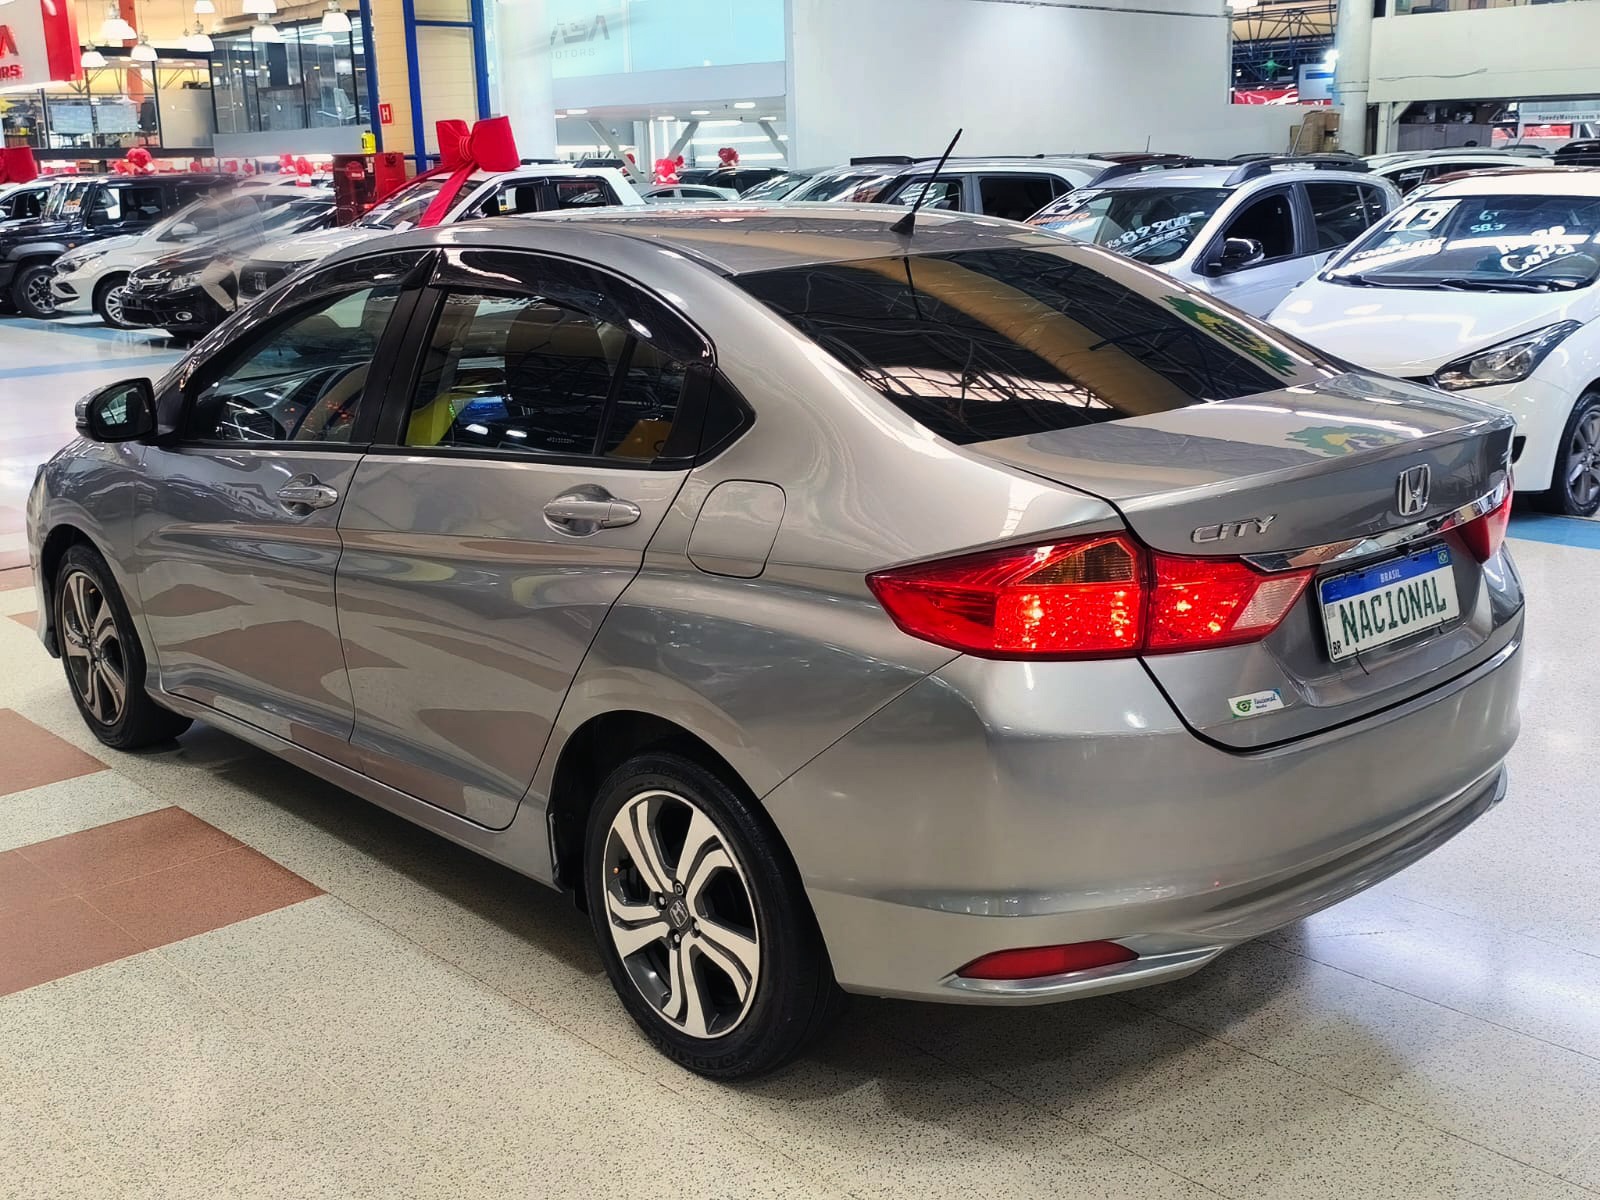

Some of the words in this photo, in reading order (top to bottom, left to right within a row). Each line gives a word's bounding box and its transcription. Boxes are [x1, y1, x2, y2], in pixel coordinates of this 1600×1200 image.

[1192, 514, 1276, 544] CITY
[1380, 568, 1402, 583] BRASIL
[1340, 576, 1447, 646] NACIONAL
[1332, 640, 1342, 655] BR
